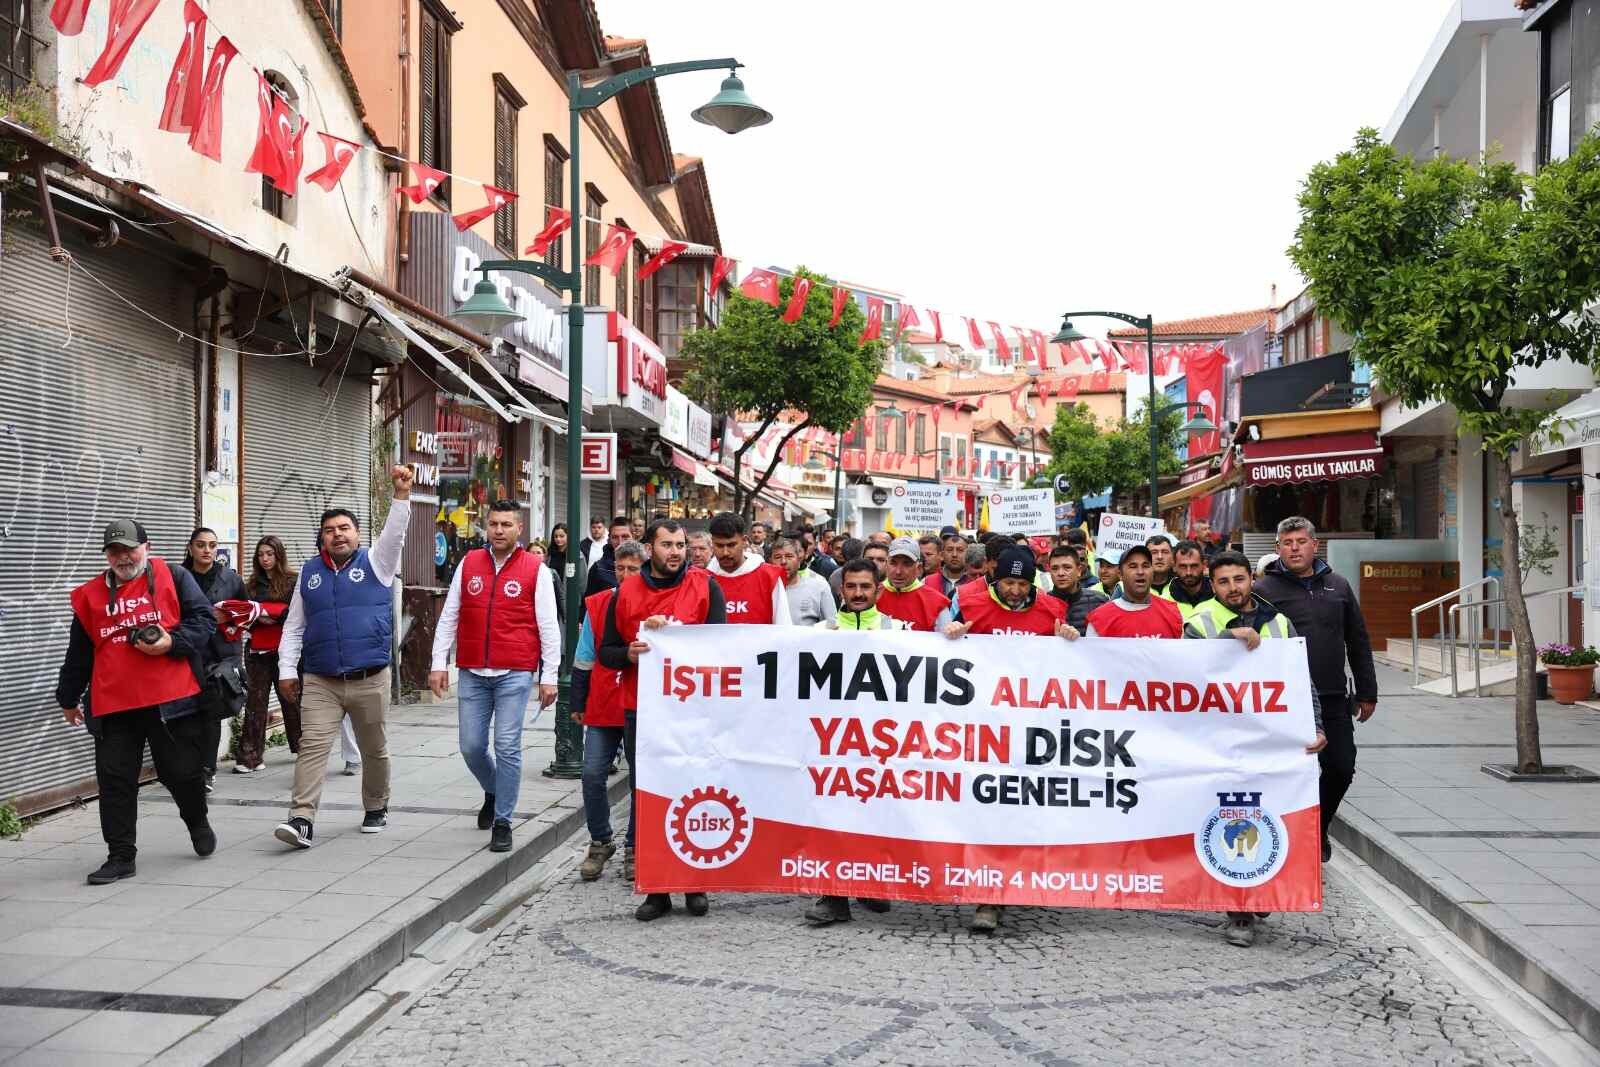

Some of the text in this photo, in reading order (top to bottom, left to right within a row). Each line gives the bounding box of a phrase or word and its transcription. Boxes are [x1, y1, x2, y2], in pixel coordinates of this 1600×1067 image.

[415, 430, 438, 454] EMRE
[583, 445, 601, 467] E
[1252, 458, 1375, 480] GÜMÜŞ ÇELİK TAKILAR
[1115, 530, 1145, 541] ÖRGÜTLÜ
[1118, 520, 1145, 531] YAŞASIN
[662, 651, 1288, 713] İŞTE 1 MAYIS ALANLARDAYIZ
[809, 717, 1136, 767] YAŞASIN DİSK
[807, 766, 1139, 814] YAŞASIN GENEL-İŞ
[688, 812, 731, 832] DİSK
[781, 855, 831, 879] DİSK
[835, 857, 931, 888] GENEL-İŞ
[944, 862, 1003, 888] İZMİR
[1009, 871, 1025, 889] 4
[1104, 873, 1164, 896] ŞUBE
